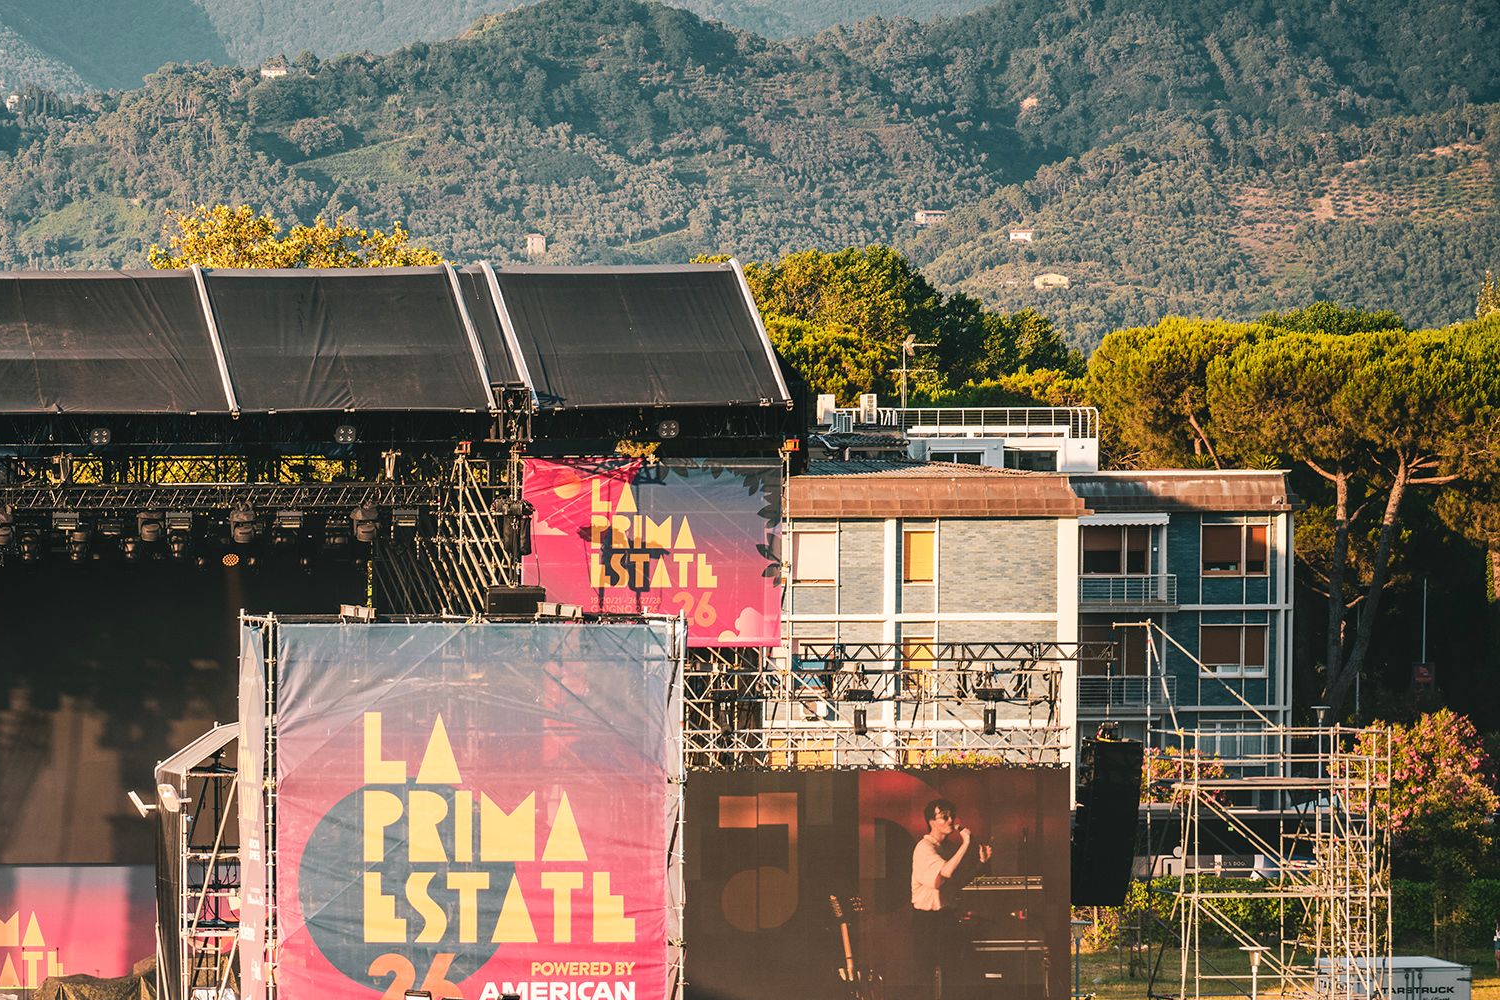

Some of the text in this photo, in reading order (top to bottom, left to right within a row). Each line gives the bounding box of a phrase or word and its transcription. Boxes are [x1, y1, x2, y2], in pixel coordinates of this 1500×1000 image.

[591, 478, 638, 513] LA
[590, 515, 696, 549] PRIMA
[590, 553, 718, 588] ESTATE
[636, 604, 658, 613] 226
[672, 591, 717, 627] 26
[363, 711, 463, 784] LA
[363, 790, 588, 862] PRIMA
[363, 872, 636, 943] ESTATE
[531, 962, 636, 976] POWERED BY
[1379, 986, 1455, 994] TARSTRUCK
